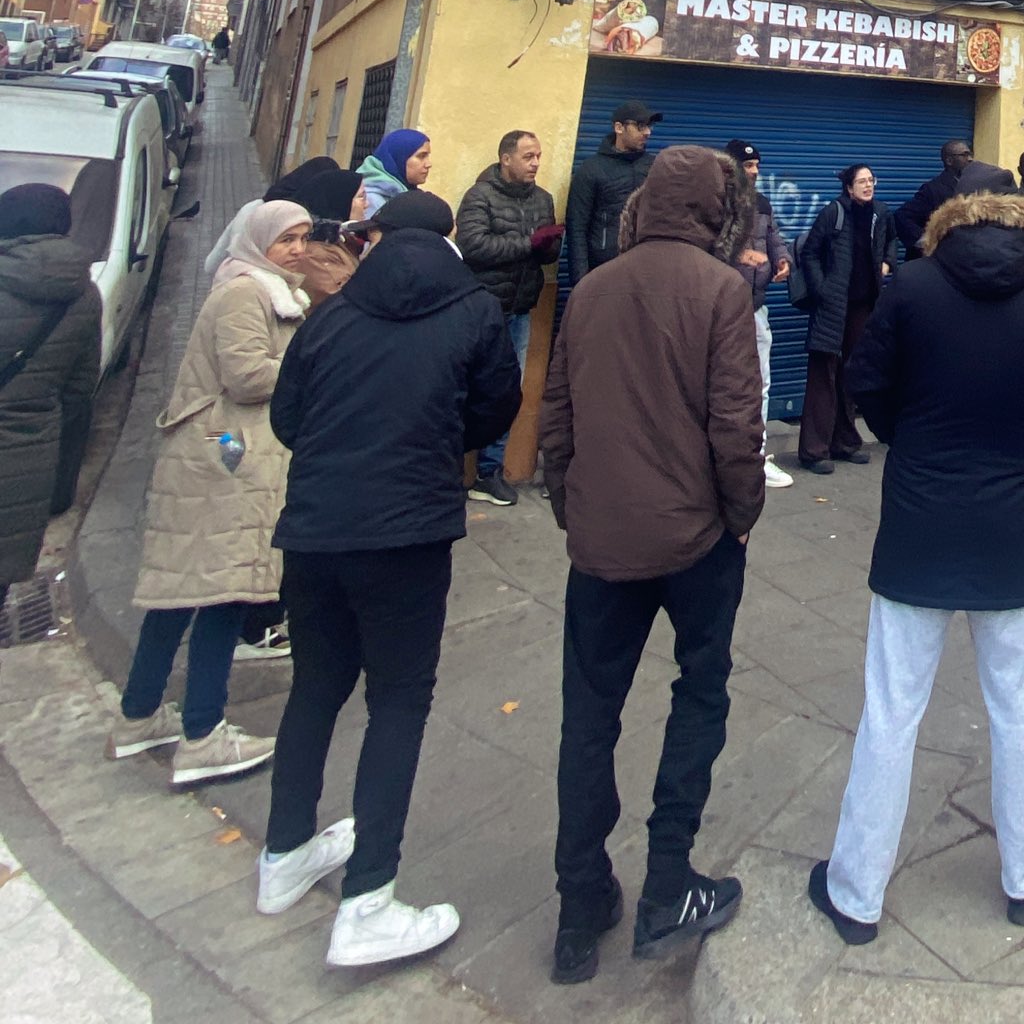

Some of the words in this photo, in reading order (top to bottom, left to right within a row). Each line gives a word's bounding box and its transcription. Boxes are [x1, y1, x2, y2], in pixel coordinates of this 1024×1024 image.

[815, 8, 955, 44] KEBABISH
[736, 34, 760, 58] &
[769, 36, 907, 70] PIZZERÍA
